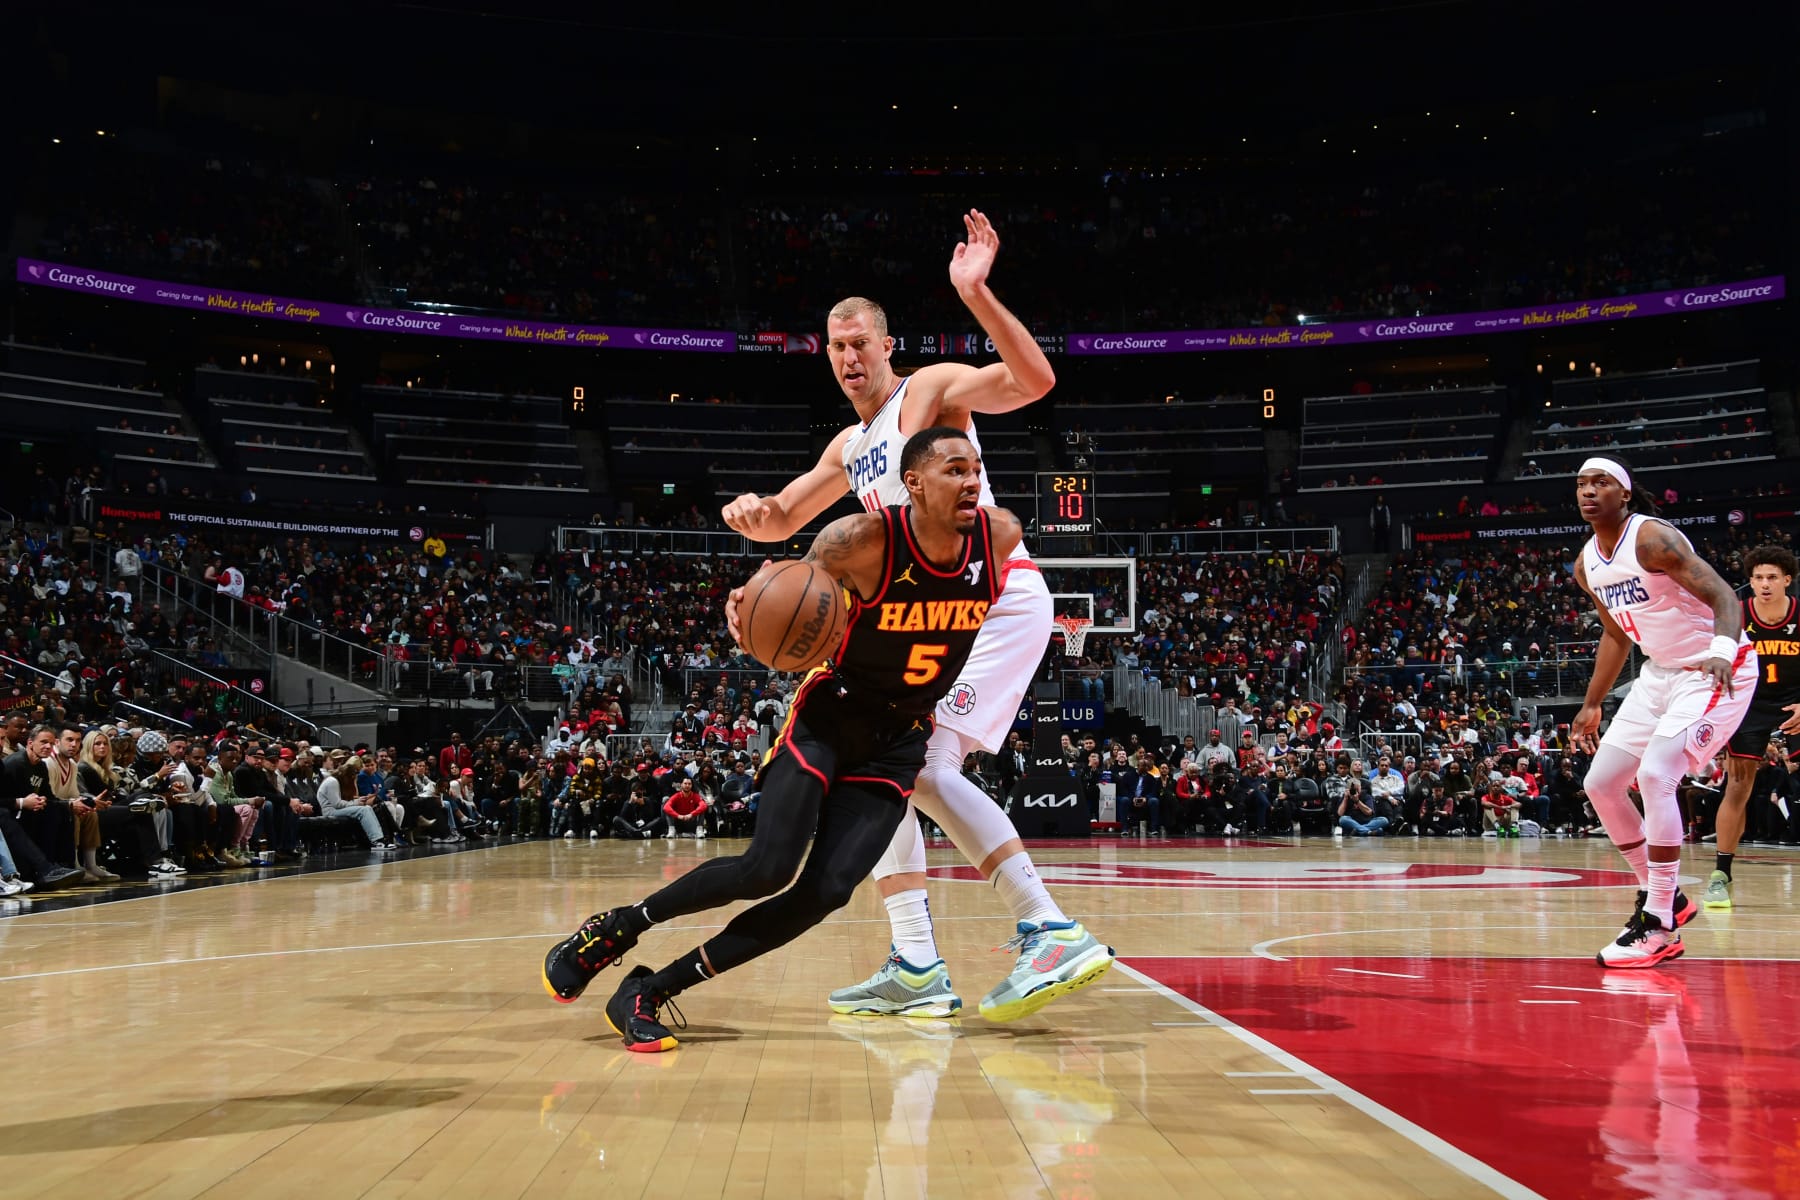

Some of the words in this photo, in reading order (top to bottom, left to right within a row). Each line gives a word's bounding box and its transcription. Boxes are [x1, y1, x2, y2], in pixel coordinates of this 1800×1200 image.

[48, 268, 136, 294] CareSource
[1683, 285, 1772, 306] CareSource
[156, 290, 180, 301] Caring
[181, 293, 192, 301] for
[193, 294, 205, 302] the
[207, 294, 239, 309] Whole
[241, 298, 276, 314] Health
[284, 303, 321, 322] Georgia
[1474, 319, 1497, 327] Caring
[1523, 311, 1553, 325] Whole
[1556, 303, 1591, 324] Health
[1590, 307, 1599, 315] of
[1600, 301, 1638, 317] Georgia
[363, 312, 441, 331] CareSource
[1376, 321, 1455, 336] CareSource
[459, 324, 481, 334] Caring
[492, 326, 503, 334] the
[505, 324, 533, 338] Whole
[536, 326, 568, 343] Health
[567, 332, 576, 340] of
[575, 329, 609, 347] Georgia
[650, 332, 724, 348] CareSource
[759, 335, 783, 343] BONUS
[922, 336, 934, 345] 10
[1094, 337, 1168, 350] CareSource
[1184, 338, 1205, 346] Caring
[1229, 333, 1257, 346] Whole
[1260, 329, 1292, 347] Health
[1291, 333, 1300, 341] of
[1300, 329, 1334, 344] Georgia
[738, 344, 773, 352] TIMEOUTS
[919, 346, 937, 354] 2ND
[1264, 389, 1274, 402] 0
[1264, 406, 1274, 418] 0
[1053, 477, 1087, 492] 2:21
[1059, 493, 1083, 518] 10
[101, 504, 162, 521] Honeywell
[168, 512, 186, 522] THE
[187, 515, 226, 526] OFFICIAL
[226, 518, 282, 530] SUSTAINABLE
[283, 522, 329, 534] BUILDINGS
[329, 527, 369, 536] PARTNER
[369, 528, 383, 537] OF
[382, 528, 399, 537] THE
[1055, 524, 1092, 532] TISSOT
[1682, 517, 1696, 526] OF
[1695, 515, 1718, 524] THE
[1415, 530, 1472, 543] Honeywell
[1476, 529, 1496, 539] THE
[1497, 528, 1537, 537] OFFICIAL
[1539, 525, 1582, 535] HEALTHY
[877, 601, 990, 631] HAWKS
[785, 592, 831, 659] Wilson
[1752, 640, 1800, 656] AWKS
[902, 643, 948, 686] 5
[1765, 663, 1779, 684] 1
[1062, 708, 1095, 720] LUB
[1023, 793, 1077, 808] KIA
